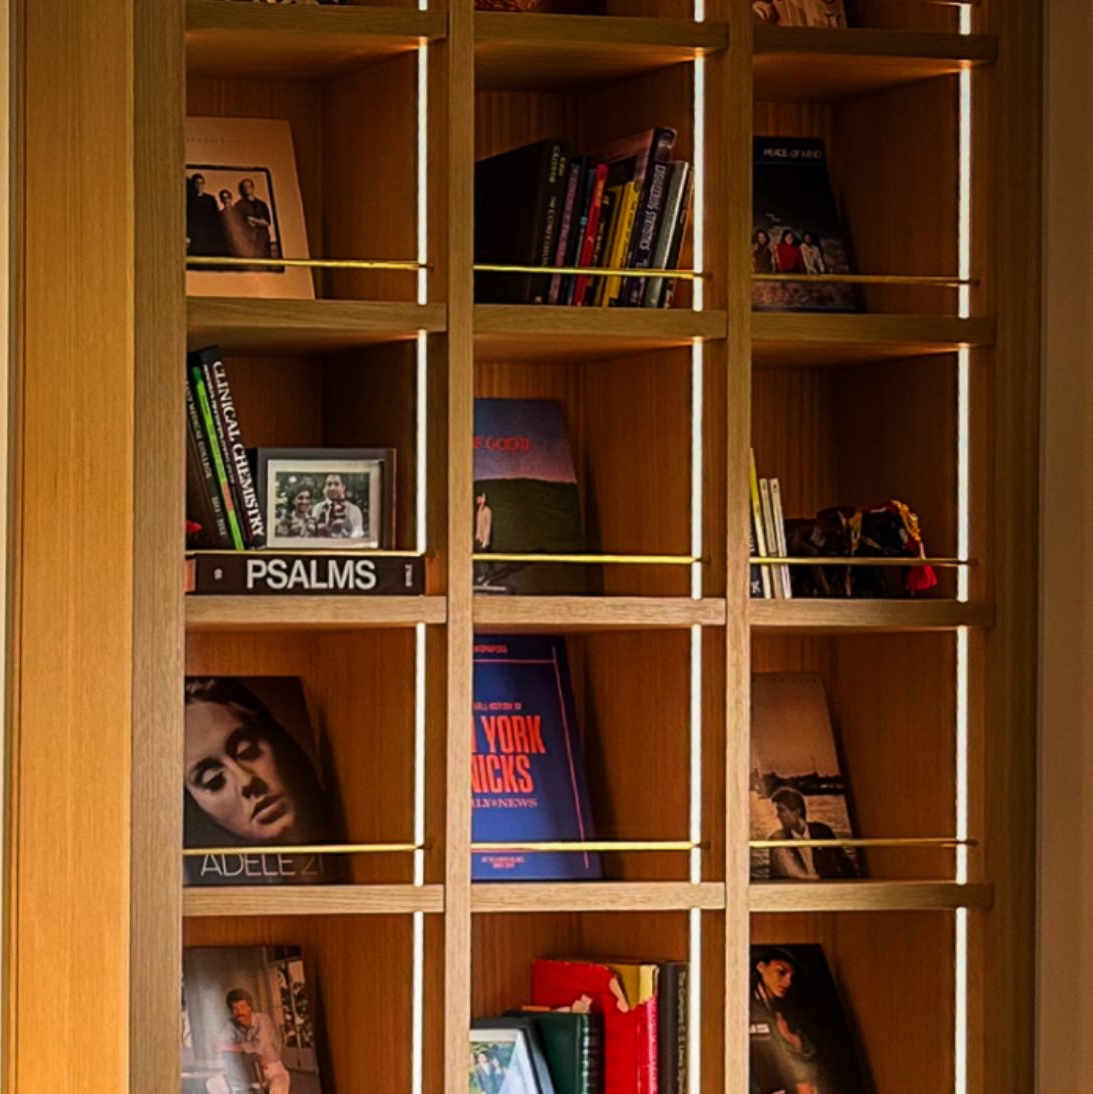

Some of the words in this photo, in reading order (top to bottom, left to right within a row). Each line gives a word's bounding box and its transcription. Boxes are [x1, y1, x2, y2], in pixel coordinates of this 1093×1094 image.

[789, 148, 801, 159] OF
[189, 402, 203, 439] MEDICAL
[198, 440, 213, 479] COLLEGE
[213, 361, 241, 442] CLINICAL
[232, 443, 265, 536] CHEMISTRY
[246, 559, 378, 590] PSALMS
[480, 715, 546, 754] YORK
[497, 798, 538, 808] NEWS
[201, 852, 296, 877] ADELE
[301, 853, 324, 875] 21
